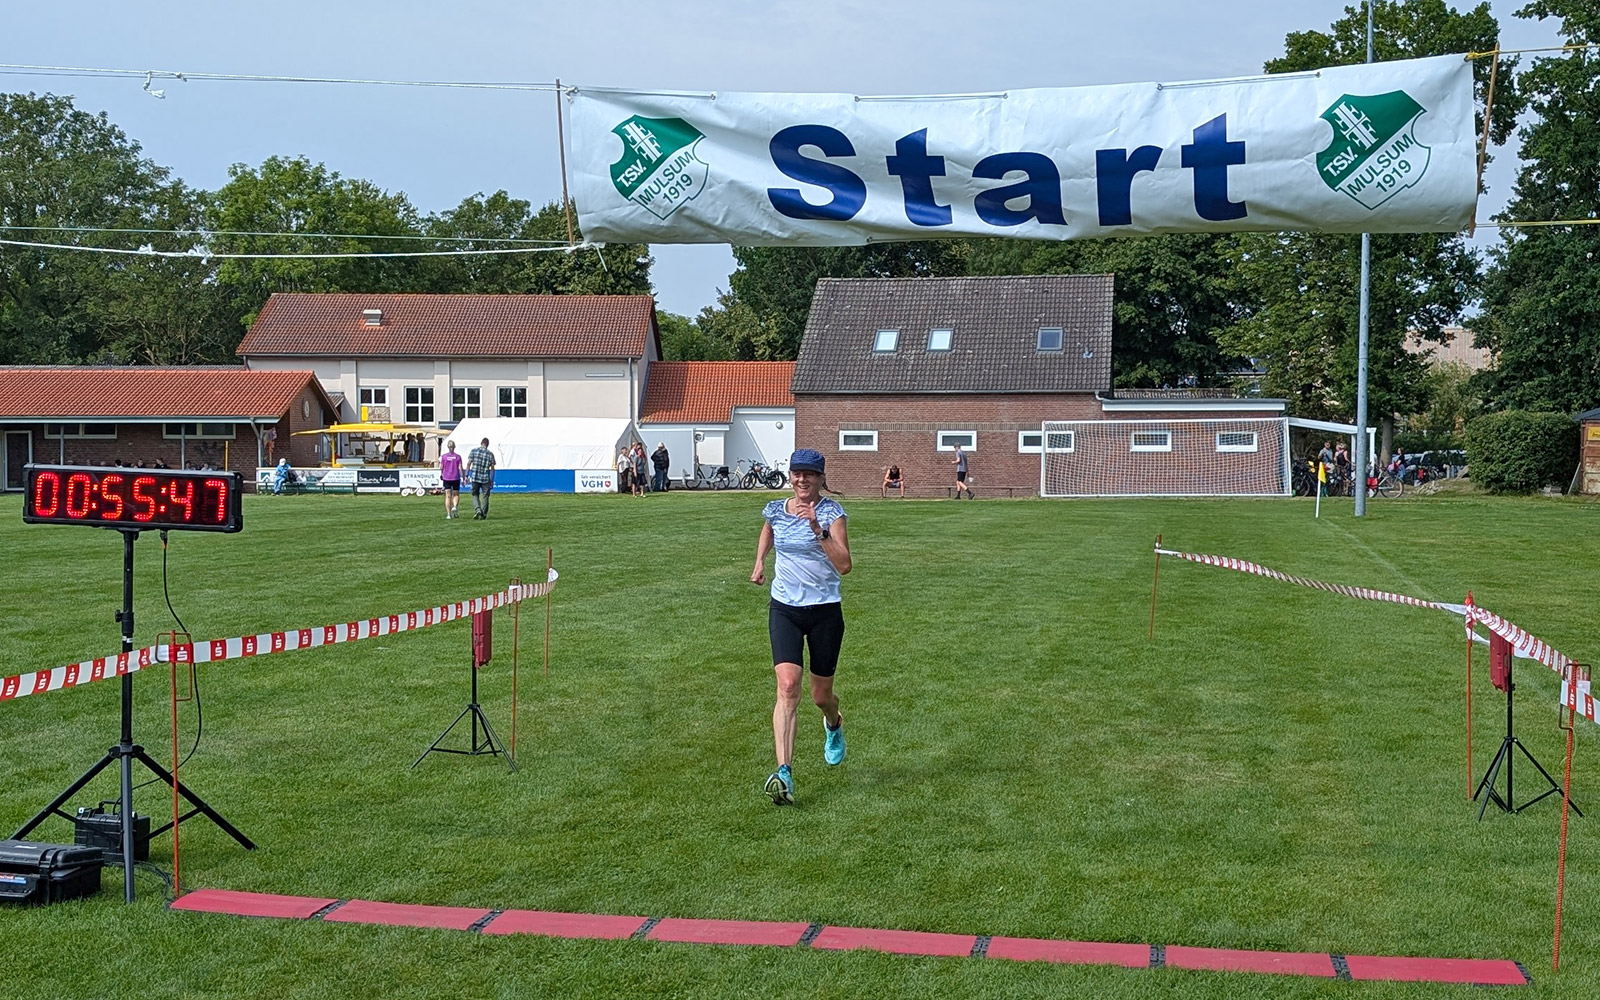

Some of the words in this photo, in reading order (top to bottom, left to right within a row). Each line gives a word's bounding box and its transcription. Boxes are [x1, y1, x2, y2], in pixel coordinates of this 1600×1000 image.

[617, 159, 647, 187] T.S.V.
[638, 151, 694, 205] MULSUM
[767, 112, 1248, 227] Start
[1323, 146, 1358, 177] T.S.V.
[1346, 133, 1414, 196] MULSUM
[1376, 159, 1411, 192] 1919
[662, 174, 693, 204] 1919
[35, 473, 226, 521] 00:55:47
[581, 480, 603, 488] VGH
